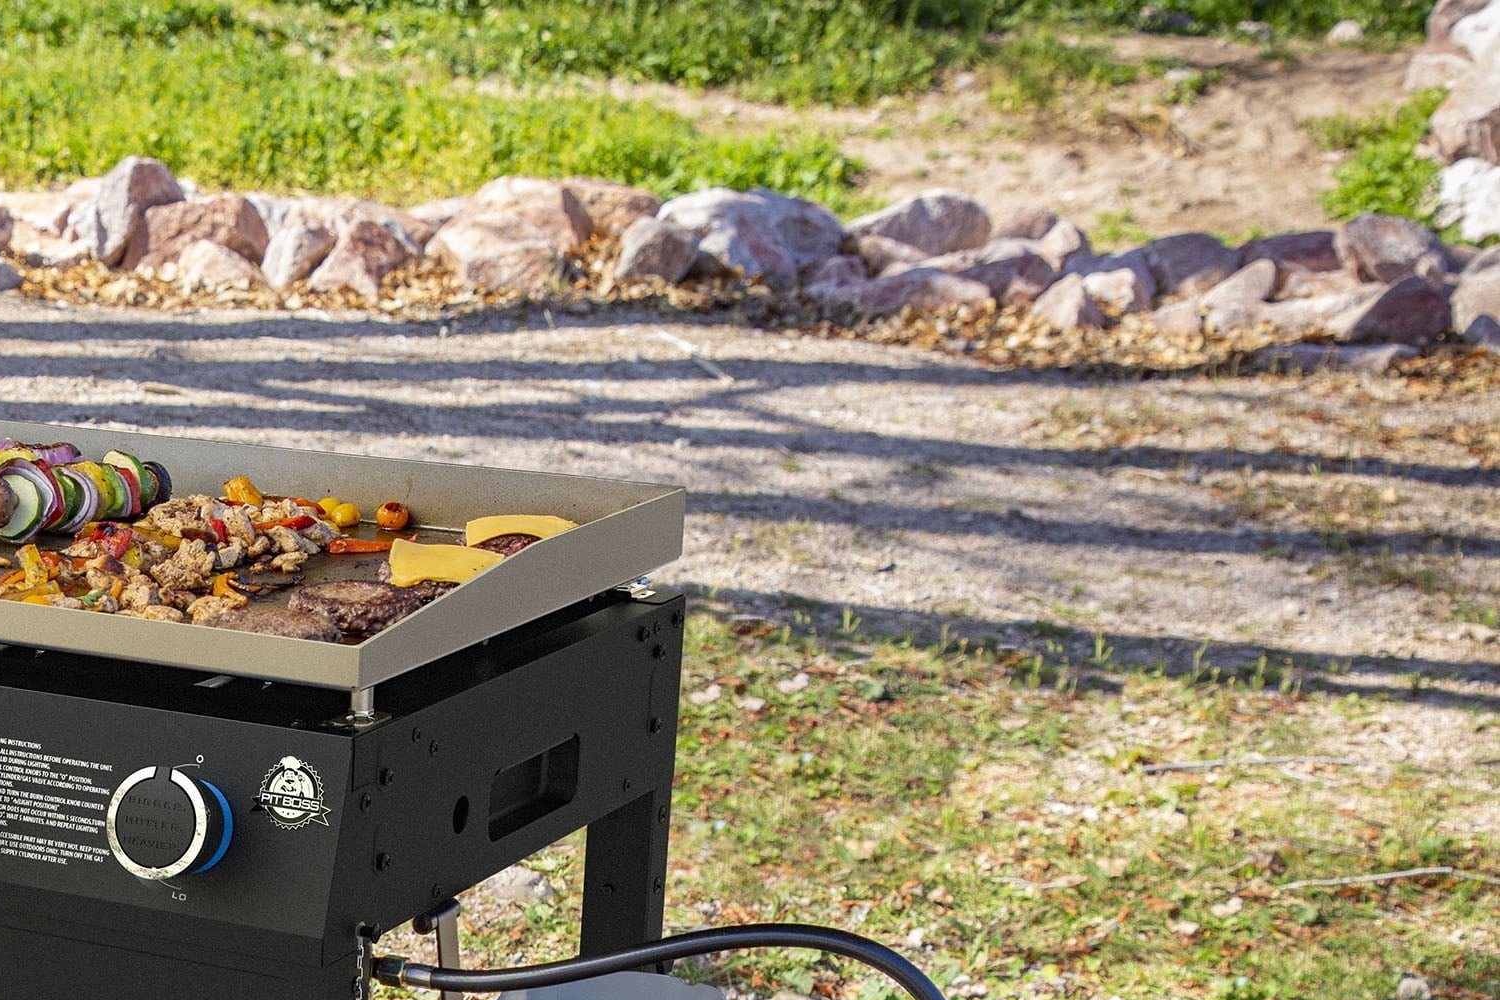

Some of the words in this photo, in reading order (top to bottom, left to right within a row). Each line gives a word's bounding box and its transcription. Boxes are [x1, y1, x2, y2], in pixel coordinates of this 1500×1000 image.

[7, 739, 42, 749] INSTRUCTIONS
[8, 749, 42, 760] INSTRUCTIONS
[43, 755, 61, 763] BEFORE
[61, 757, 89, 767] OPERATING
[8, 757, 26, 765] DURING
[27, 760, 51, 769] LIGHTING.
[2, 764, 24, 773] CONTROL
[25, 768, 41, 776] KNOBS
[49, 771, 58, 779] THE
[31, 776, 47, 785] VALVE
[46, 779, 75, 789] ACCORDING
[82, 784, 109, 795] OPERATING
[3, 795, 10, 803] TO
[6, 788, 19, 796] TURN
[44, 794, 66, 804] CONTROL
[66, 798, 80, 806] KNOB
[261, 792, 282, 805] PIT
[282, 796, 320, 811] BOSS
[6, 804, 19, 812] DOES
[30, 808, 46, 817] OCCUR
[47, 811, 65, 820] WITHIN
[6, 812, 18, 820] WAIT
[45, 818, 57, 826] AND
[57, 820, 75, 829] REPEAT
[75, 823, 98, 833] LIGHTING
[0, 847, 18, 856] SUPPLY
[18, 850, 41, 860] CYLINDER
[41, 854, 57, 862] AFTER
[9, 840, 18, 848] USE
[18, 842, 45, 852] OUTDOORS
[59, 849, 73, 857] TURN
[73, 851, 83, 859] OFF
[83, 853, 93, 861] THE
[54, 840, 67, 848] VERY
[79, 844, 92, 852] KEEP
[92, 847, 110, 855] YOUNG
